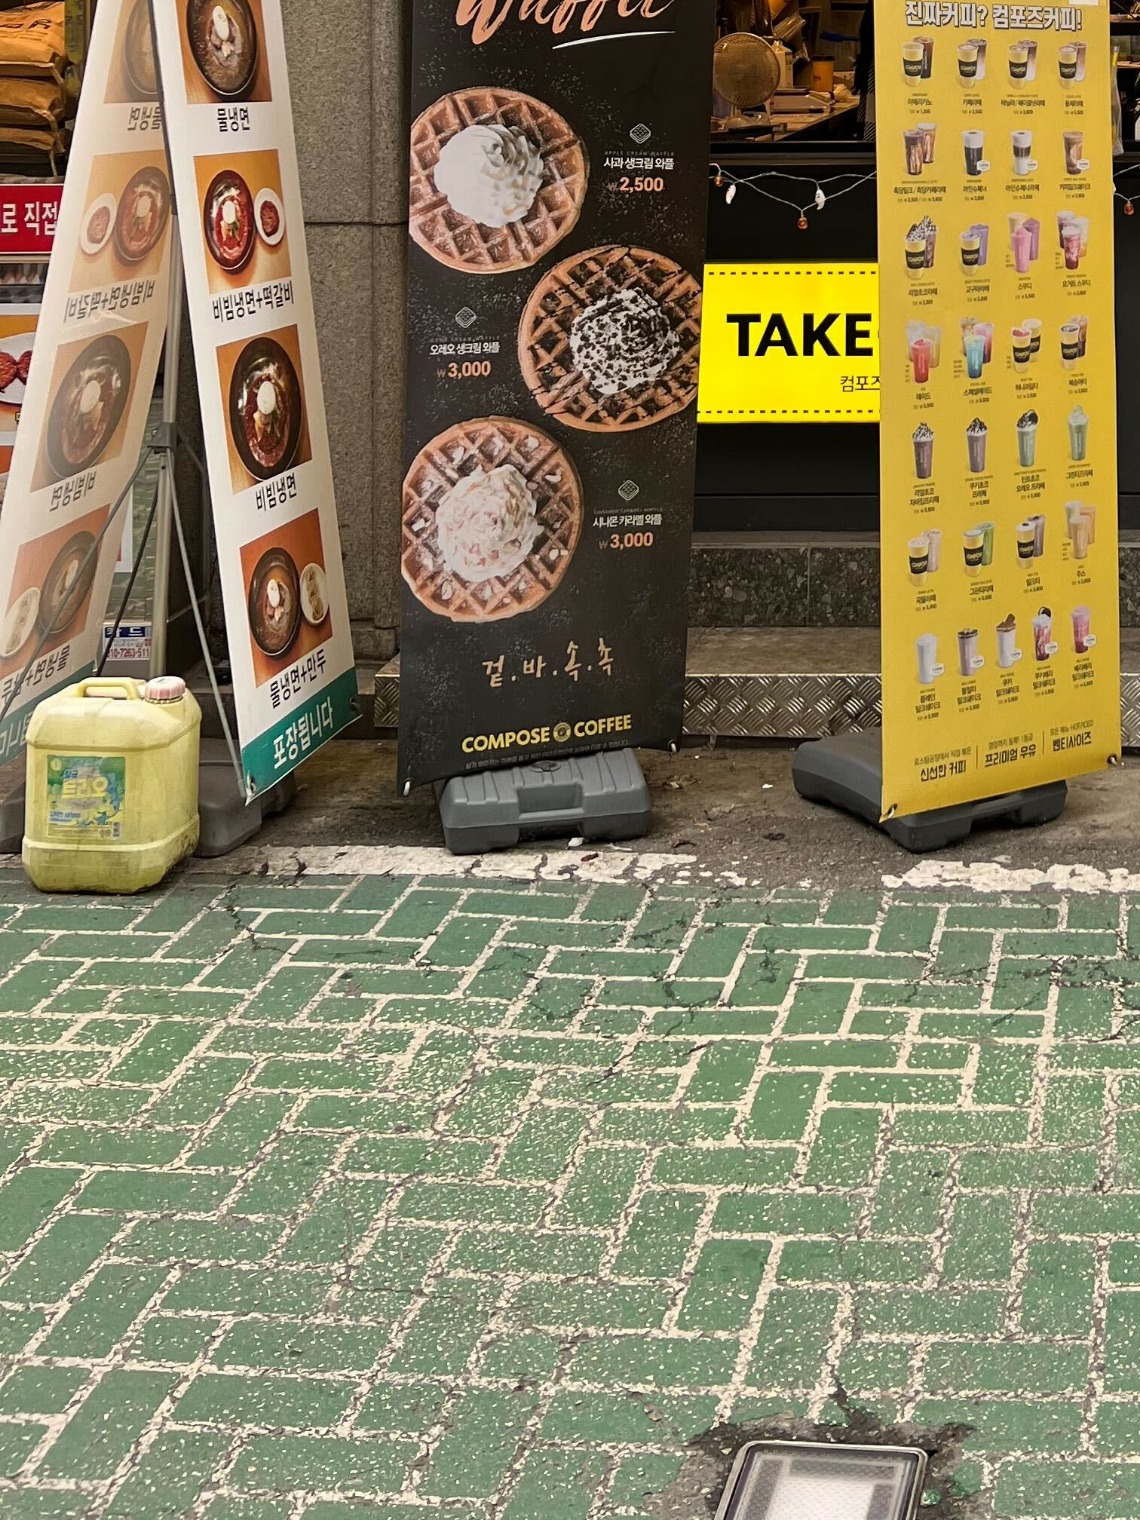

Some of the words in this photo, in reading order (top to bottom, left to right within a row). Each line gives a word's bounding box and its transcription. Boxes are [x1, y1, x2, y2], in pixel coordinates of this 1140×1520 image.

[905, 0, 988, 28] 진짜커피?
[992, 4, 1083, 31] 컴포즈커피!
[217, 106, 251, 133] 물냉면
[603, 156, 624, 170] 사과
[624, 157, 654, 170] 생크림
[654, 157, 675, 170] 와플
[24, 201, 58, 236] 직접
[212, 280, 294, 323] 비빔냉면+떡갈비
[430, 343, 456, 356] 오레오
[482, 341, 501, 354] 와플
[726, 312, 874, 357] TAKE
[255, 471, 298, 512] 비빔냉면
[592, 514, 618, 528] 시나몬
[644, 513, 663, 526] 와플
[107, 647, 151, 659] 010-7263-511
[269, 649, 327, 710] 물냉면+만두
[272, 696, 334, 772] 포장됩니다
[461, 726, 550, 753] COMPOSE
[573, 714, 633, 738] COFFEE
[1052, 731, 1093, 752] 벤티사이즈
[984, 749, 1018, 768] 프리미엄
[1019, 743, 1037, 758] 우유
[920, 764, 947, 782] 신선한
[948, 759, 967, 775] 커피
